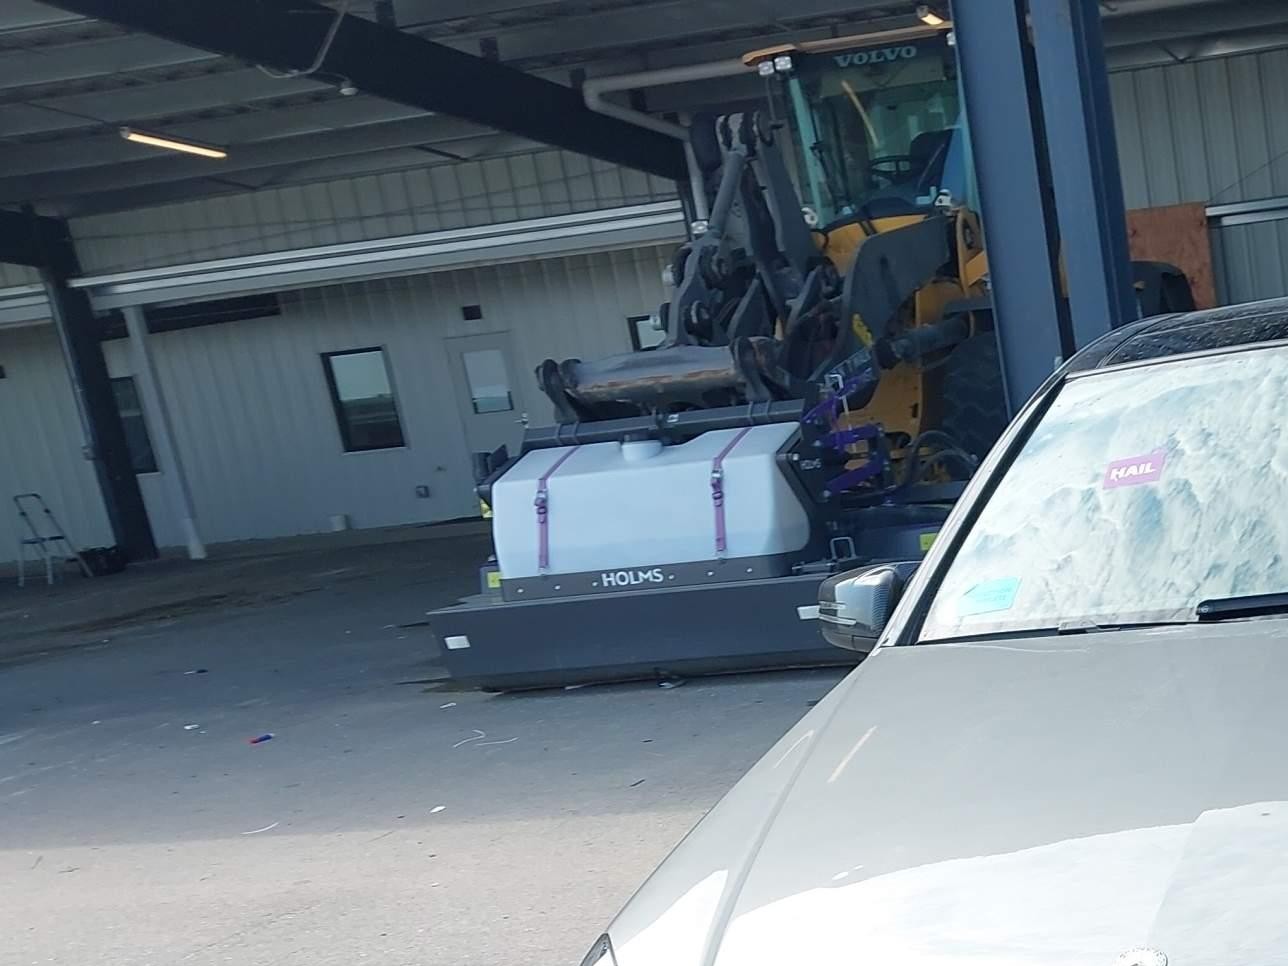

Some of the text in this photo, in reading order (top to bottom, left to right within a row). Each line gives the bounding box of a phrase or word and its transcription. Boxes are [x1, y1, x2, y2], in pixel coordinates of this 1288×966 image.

[832, 46, 917, 67] VOLVO
[1110, 462, 1156, 481] HAIL
[601, 568, 664, 587] HOLMS
